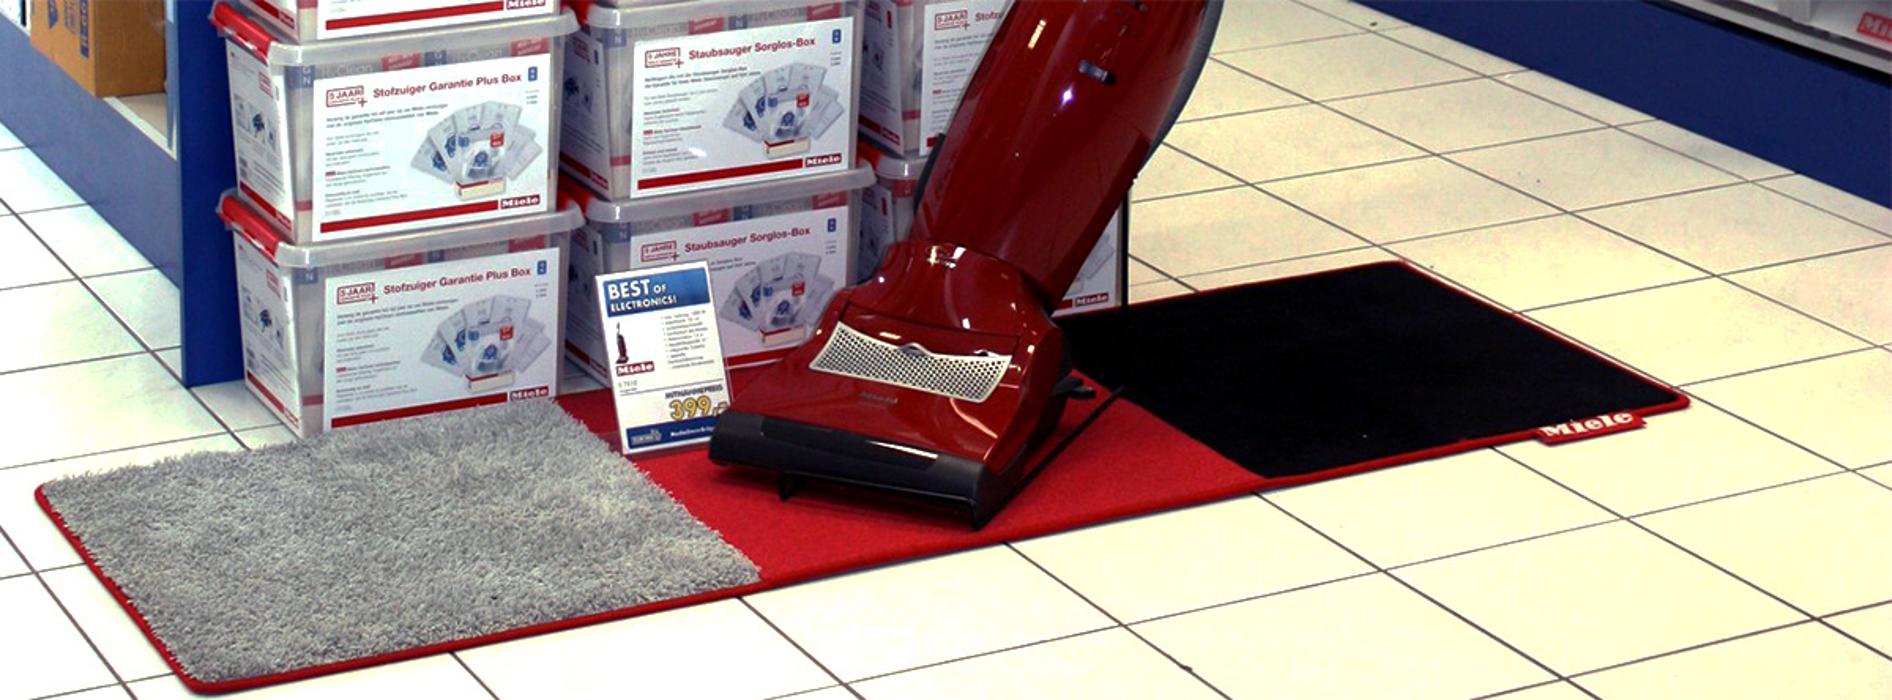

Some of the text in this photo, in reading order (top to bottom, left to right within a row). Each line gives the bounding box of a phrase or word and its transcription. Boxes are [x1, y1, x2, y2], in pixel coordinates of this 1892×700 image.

[689, 37, 816, 60] Staubsauger Sorglos-Box
[373, 73, 522, 99] Stofzuiger Garantie Plus Box
[807, 156, 841, 167] Miele
[502, 196, 539, 207] Miele
[684, 227, 810, 253] Staubsauger Sorglos-Box
[383, 267, 531, 295] Stofzuiger Garantie Plus Box
[607, 279, 667, 300] BEST OF
[611, 295, 677, 312] ELECTRONICS!
[617, 362, 654, 375] Miele
[511, 387, 548, 400] Miele
[1539, 412, 1634, 437] Miele
